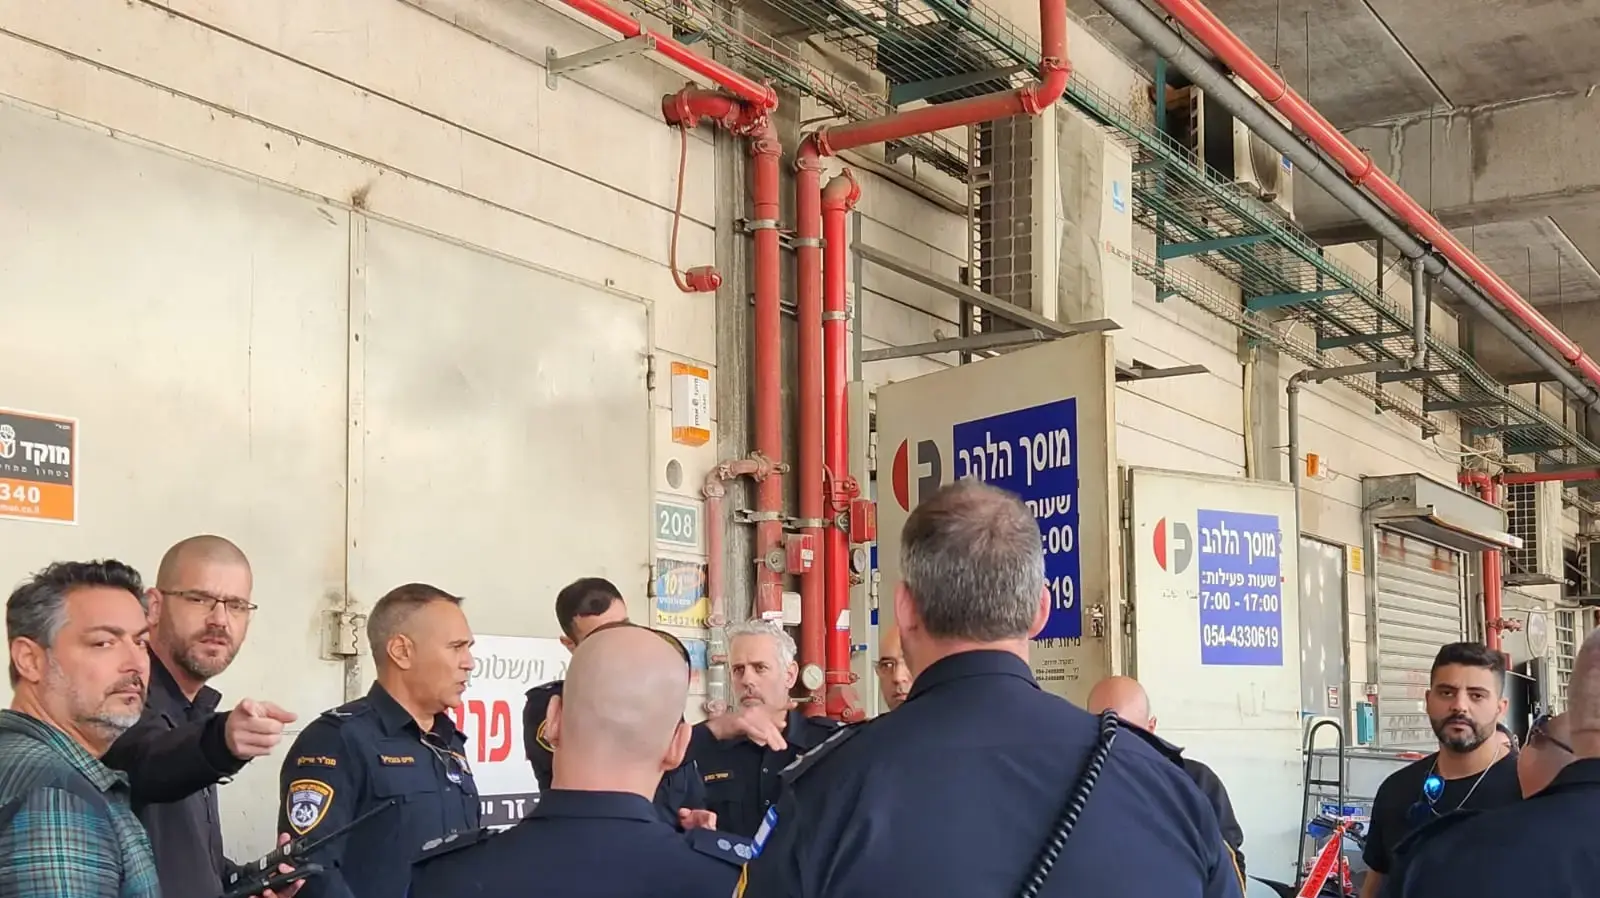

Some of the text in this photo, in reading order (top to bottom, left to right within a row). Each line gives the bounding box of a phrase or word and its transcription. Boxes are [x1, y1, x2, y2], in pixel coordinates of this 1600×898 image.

[20, 440, 70, 466] מוקד
[959, 428, 1071, 486] מוסך הלהב
[660, 510, 692, 538] 208
[1201, 520, 1276, 565] מוסך הלהב
[1202, 567, 1277, 588] שעות פעילות:
[1043, 575, 1074, 609] 19
[1201, 591, 1231, 610] 7:00
[1243, 593, 1279, 612] 17:00
[1203, 624, 1279, 648] 054-4330619
